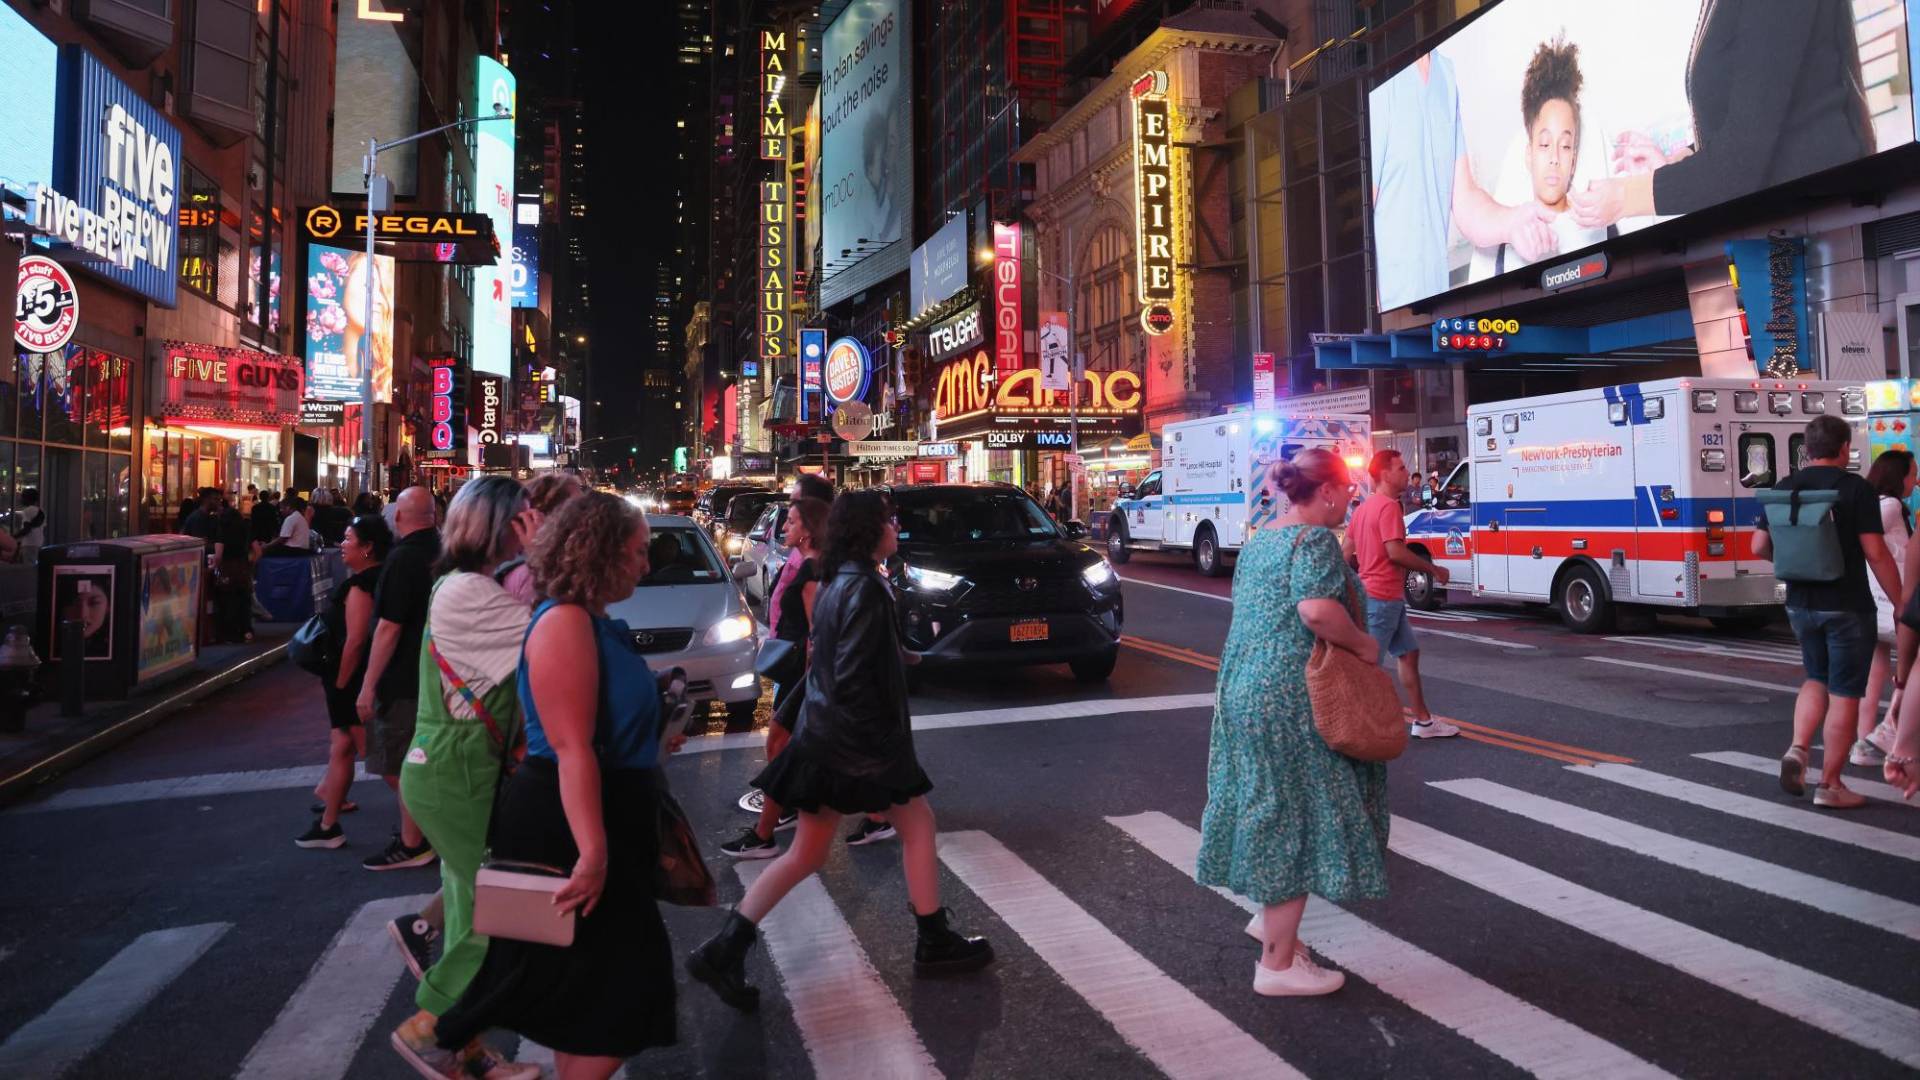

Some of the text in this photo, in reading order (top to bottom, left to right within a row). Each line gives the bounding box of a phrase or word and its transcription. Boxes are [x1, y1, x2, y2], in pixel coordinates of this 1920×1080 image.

[833, 52, 852, 93] plan
[854, 10, 894, 63] savings
[764, 31, 786, 158] MADAME
[822, 62, 889, 136] hout the noise
[106, 103, 174, 216] five
[36, 185, 79, 242] five
[1144, 112, 1171, 290] EMPIRE
[105, 185, 171, 271] BELOW
[355, 215, 477, 235] REGAL
[83, 208, 135, 270] BELOW
[29, 263, 53, 278] stuff
[764, 181, 784, 356] TUSSAUD'S
[1545, 264, 1581, 287] branded
[1149, 313, 1171, 323] amc
[1439, 319, 1448, 330] A
[1454, 320, 1462, 331] C
[1467, 320, 1475, 331] E
[1481, 320, 1490, 331] N
[1509, 321, 1517, 332] R
[17, 324, 43, 344] five
[929, 308, 982, 357] IT'SUGAR
[1440, 336, 1448, 347] S
[1468, 336, 1476, 347] 2
[1482, 337, 1490, 348] 3
[1496, 337, 1504, 348] 7
[1841, 345, 1865, 354] eleven
[173, 356, 227, 383] FIVE
[237, 363, 299, 391] GUYS
[829, 352, 857, 378] DAVE &
[830, 366, 859, 392] BUSTER'S
[935, 350, 990, 419] amc
[996, 369, 1141, 409] amc
[308, 403, 343, 413] WESTIN
[432, 367, 453, 450] BBQ
[482, 380, 498, 430] target
[1520, 410, 1535, 421] 1821
[856, 444, 881, 452] Hilton
[928, 444, 956, 456] GIFTS
[988, 433, 1024, 443] DOLBY
[1702, 433, 1724, 446] 1821
